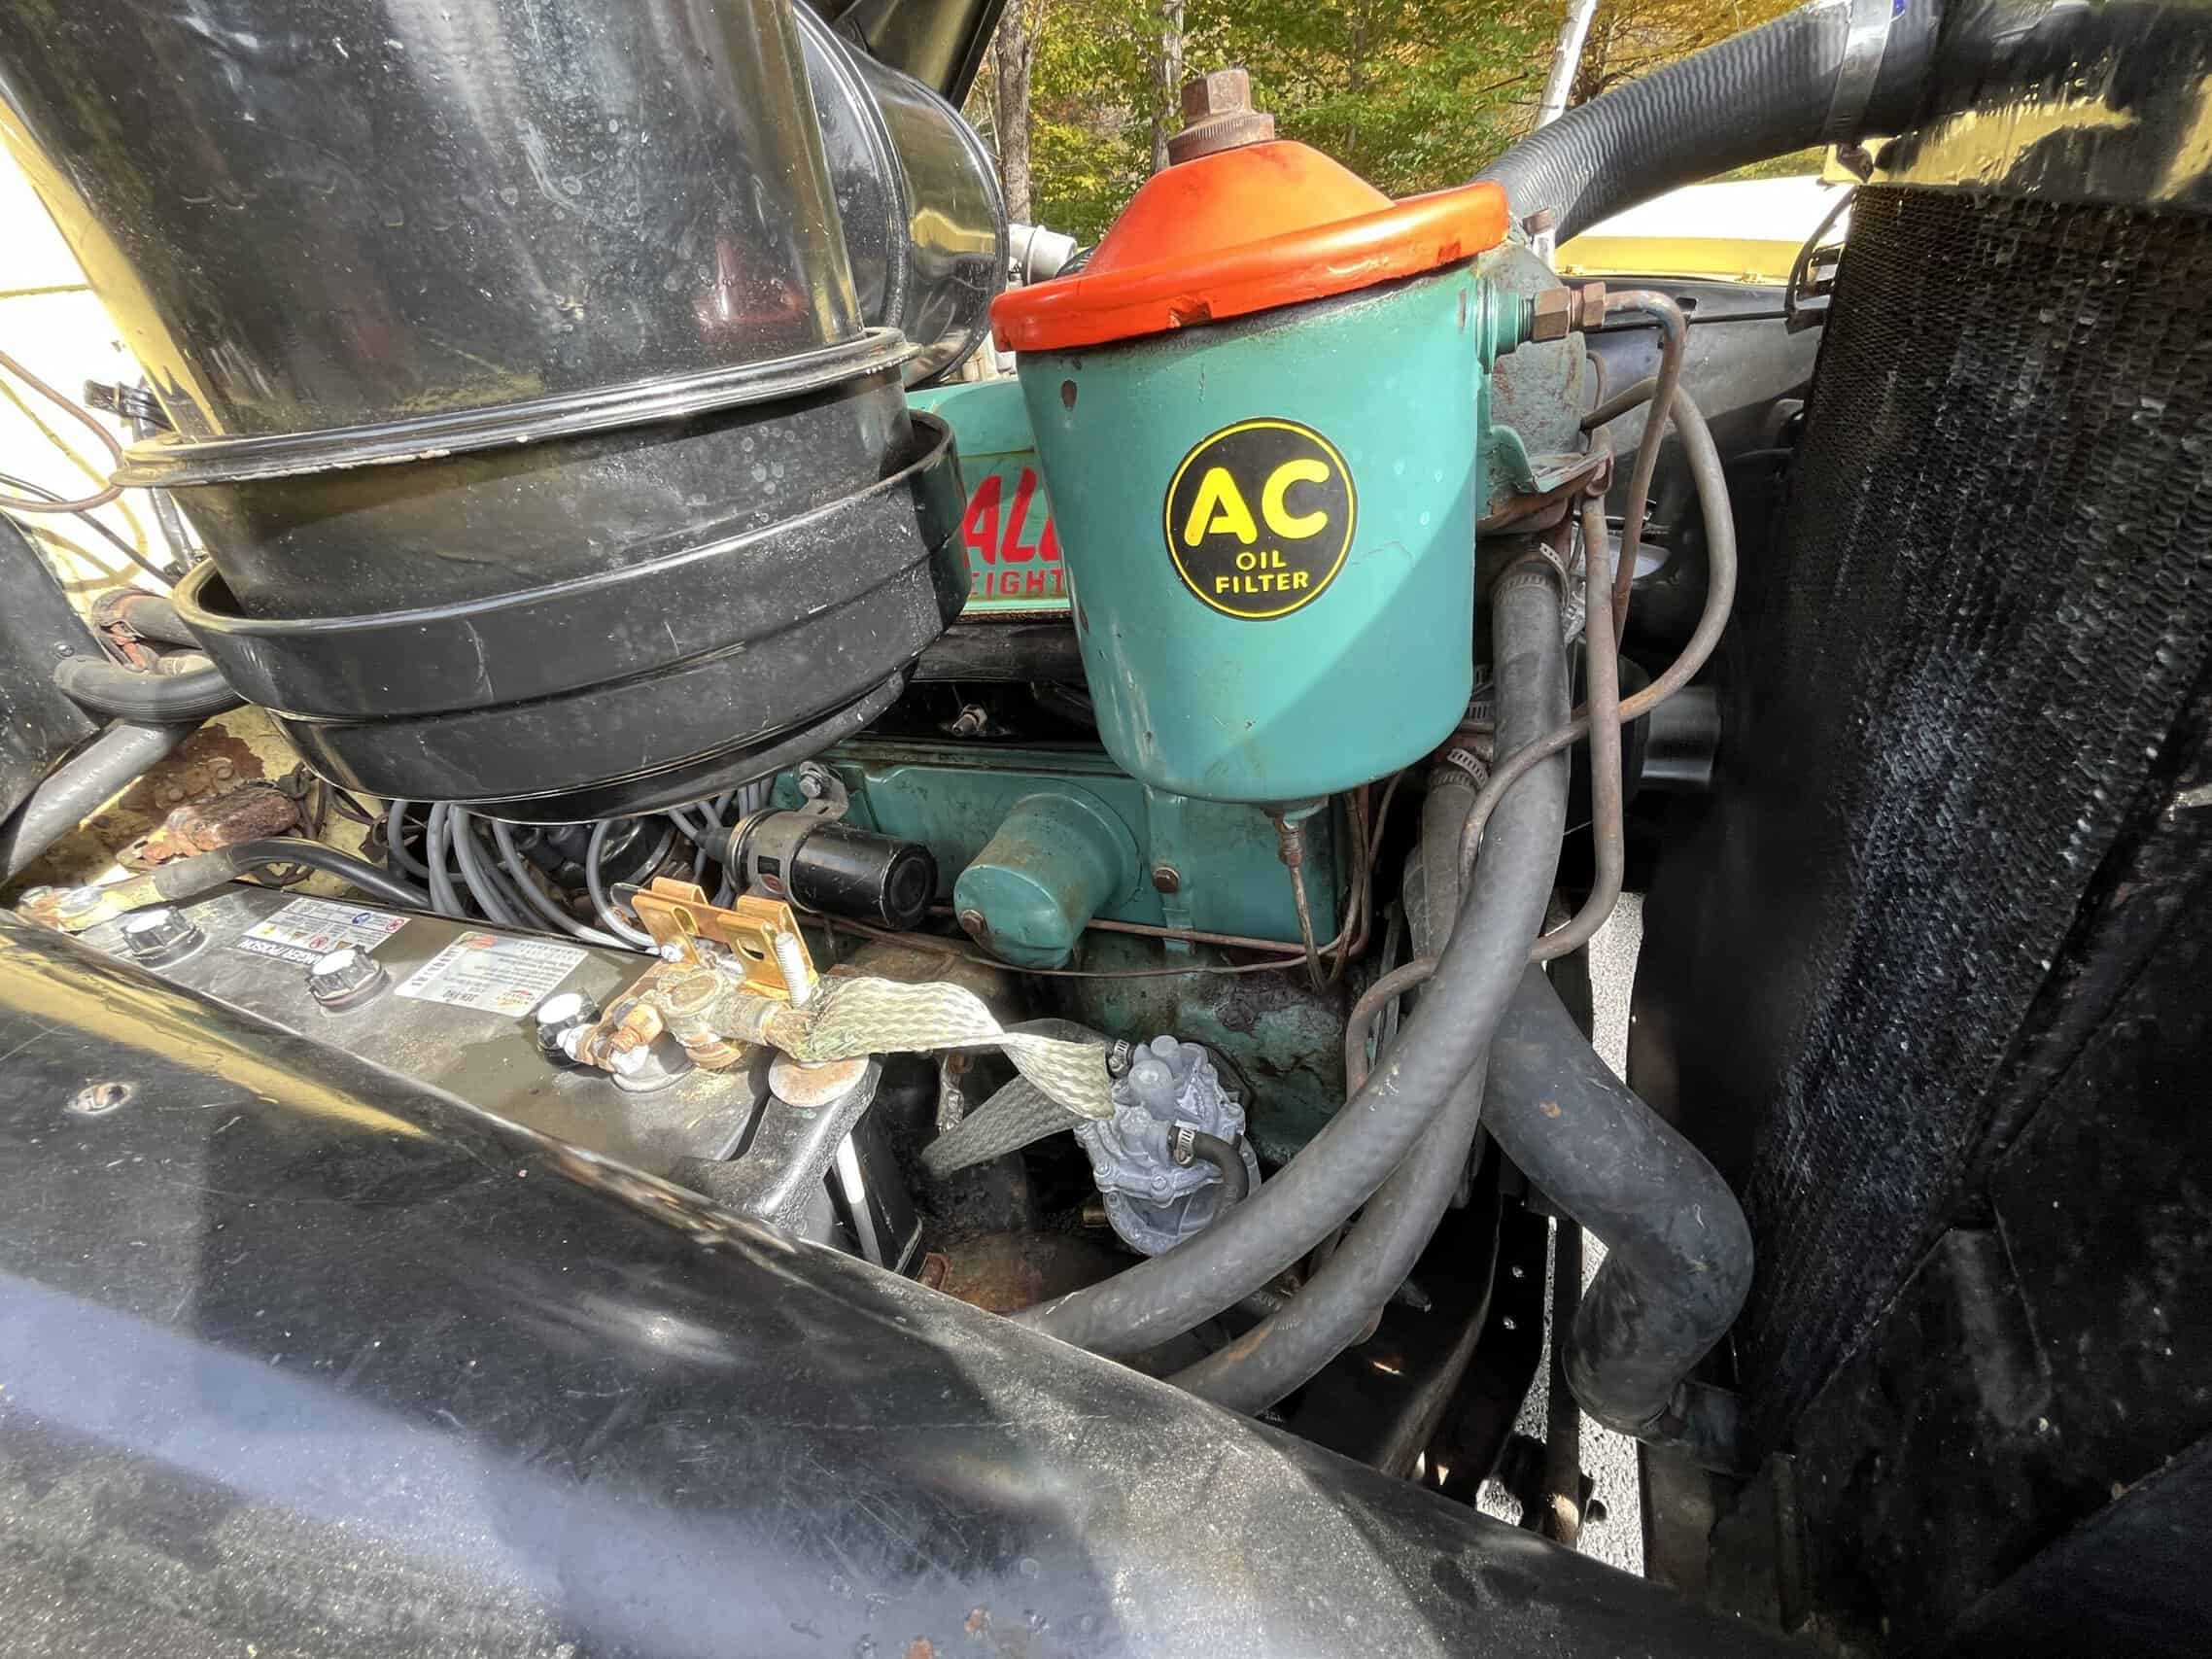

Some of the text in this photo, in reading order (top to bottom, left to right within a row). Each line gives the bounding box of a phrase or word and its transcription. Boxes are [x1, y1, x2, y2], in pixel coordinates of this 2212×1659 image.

[1184, 459, 1330, 546] AC
[1235, 549, 1287, 570] OIL
[1215, 570, 1309, 594] FILTER
